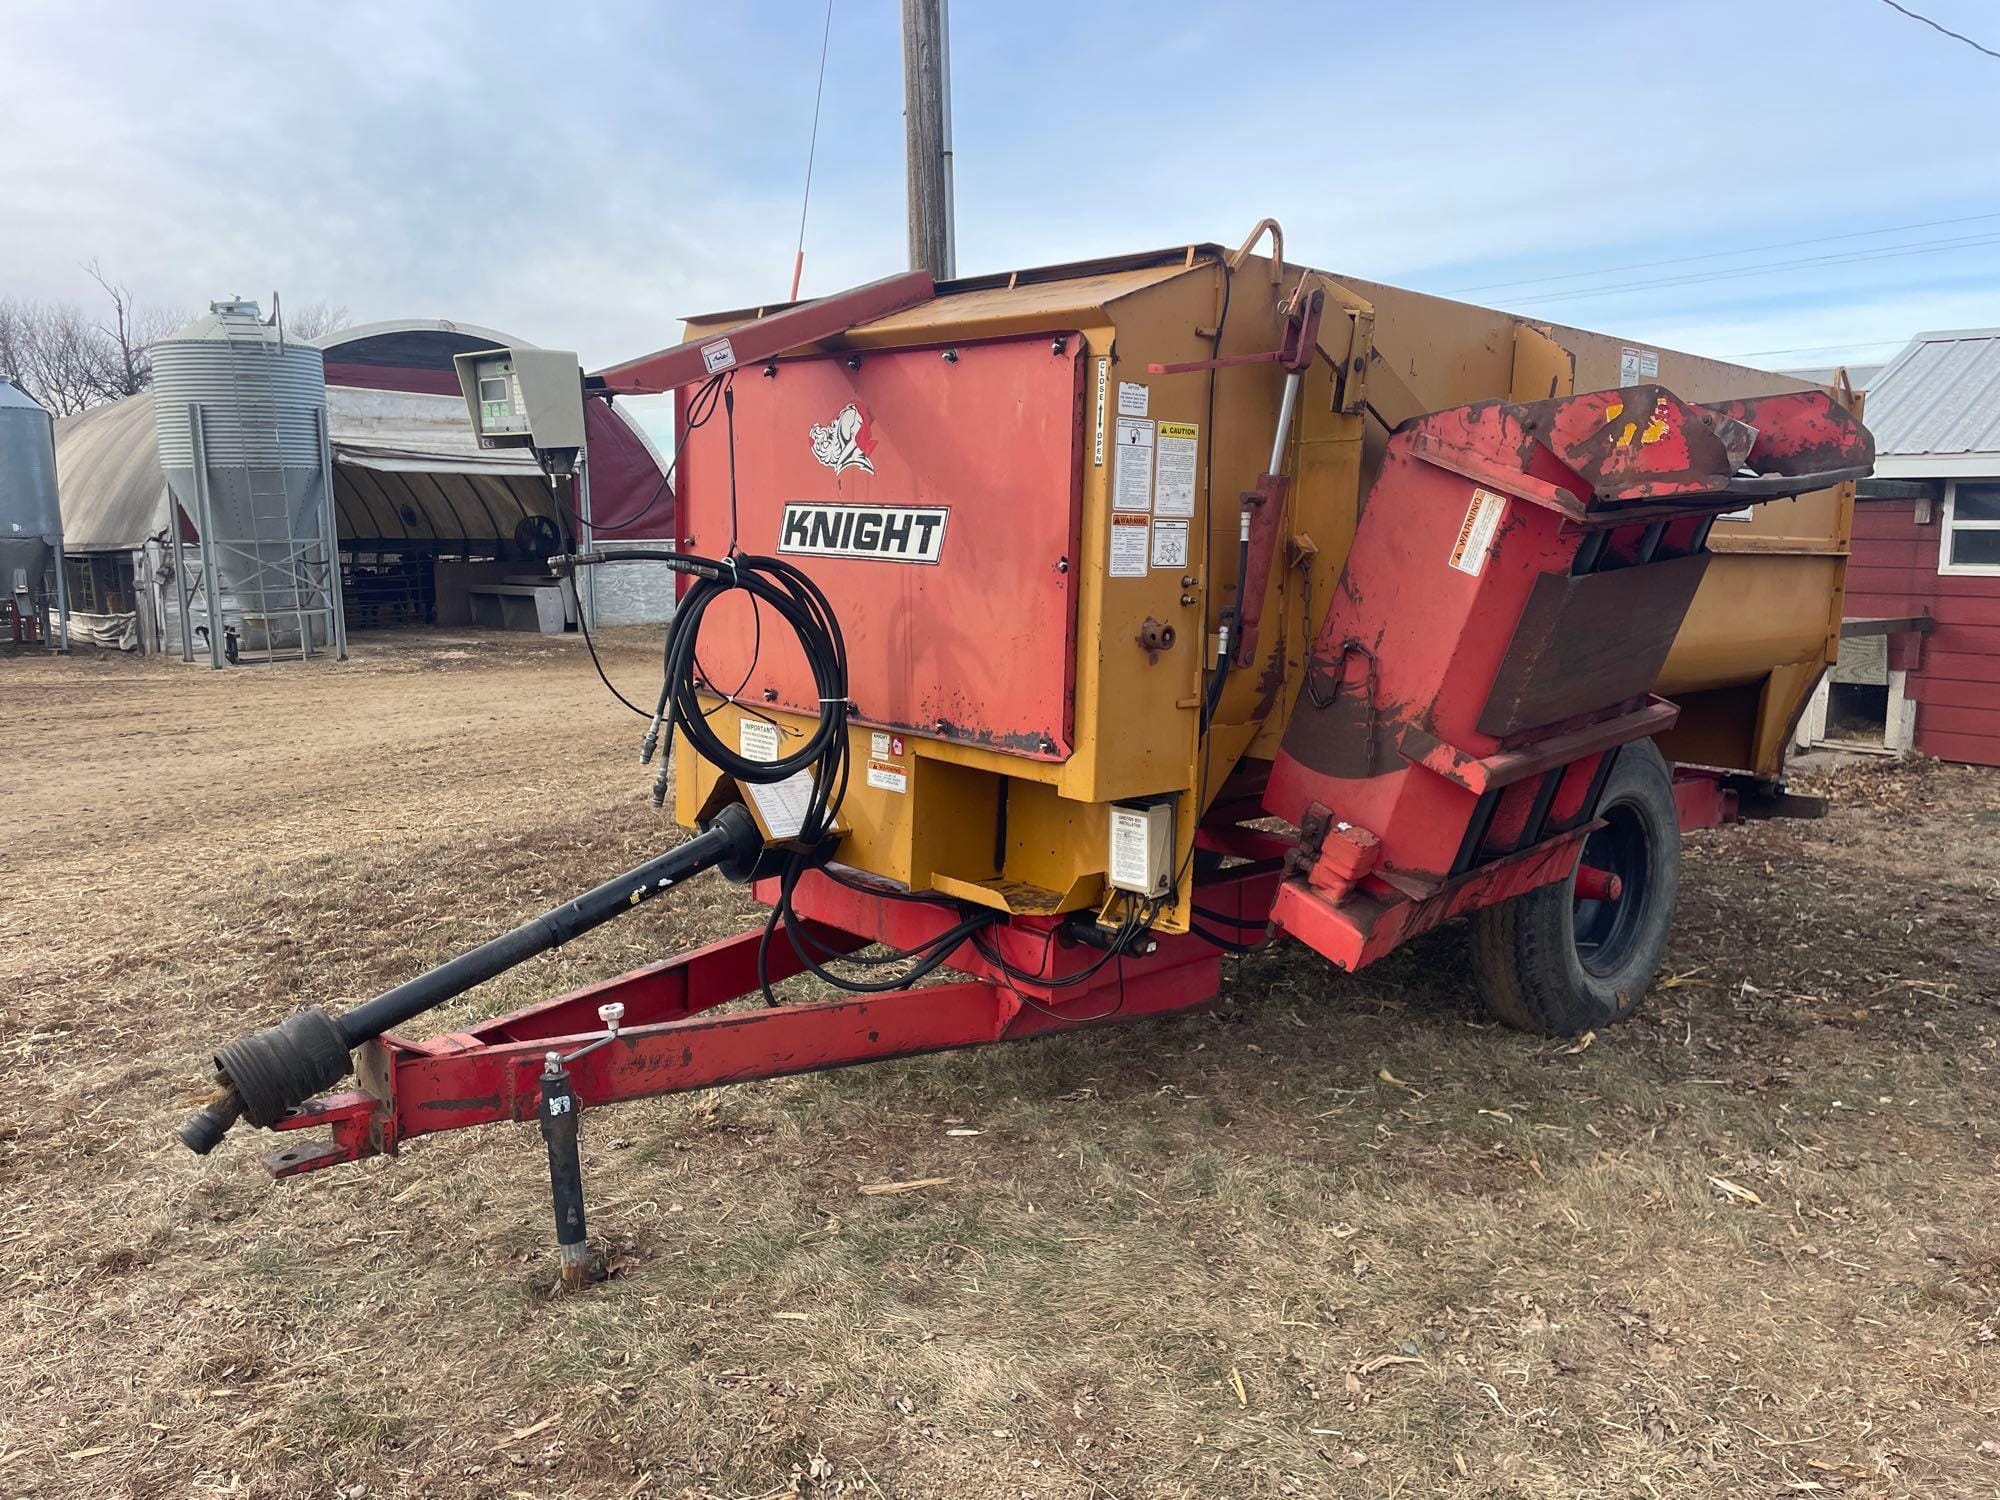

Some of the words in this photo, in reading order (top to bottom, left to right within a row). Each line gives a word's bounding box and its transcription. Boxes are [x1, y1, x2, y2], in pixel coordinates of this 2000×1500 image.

[1169, 427, 1196, 436] CAUTION
[1095, 432, 1103, 462] OPEN
[1119, 517, 1147, 525] WARNING
[1459, 497, 1483, 545] WARNING
[783, 510, 942, 554] KNIGHT
[745, 723, 774, 735] IMPORTANT
